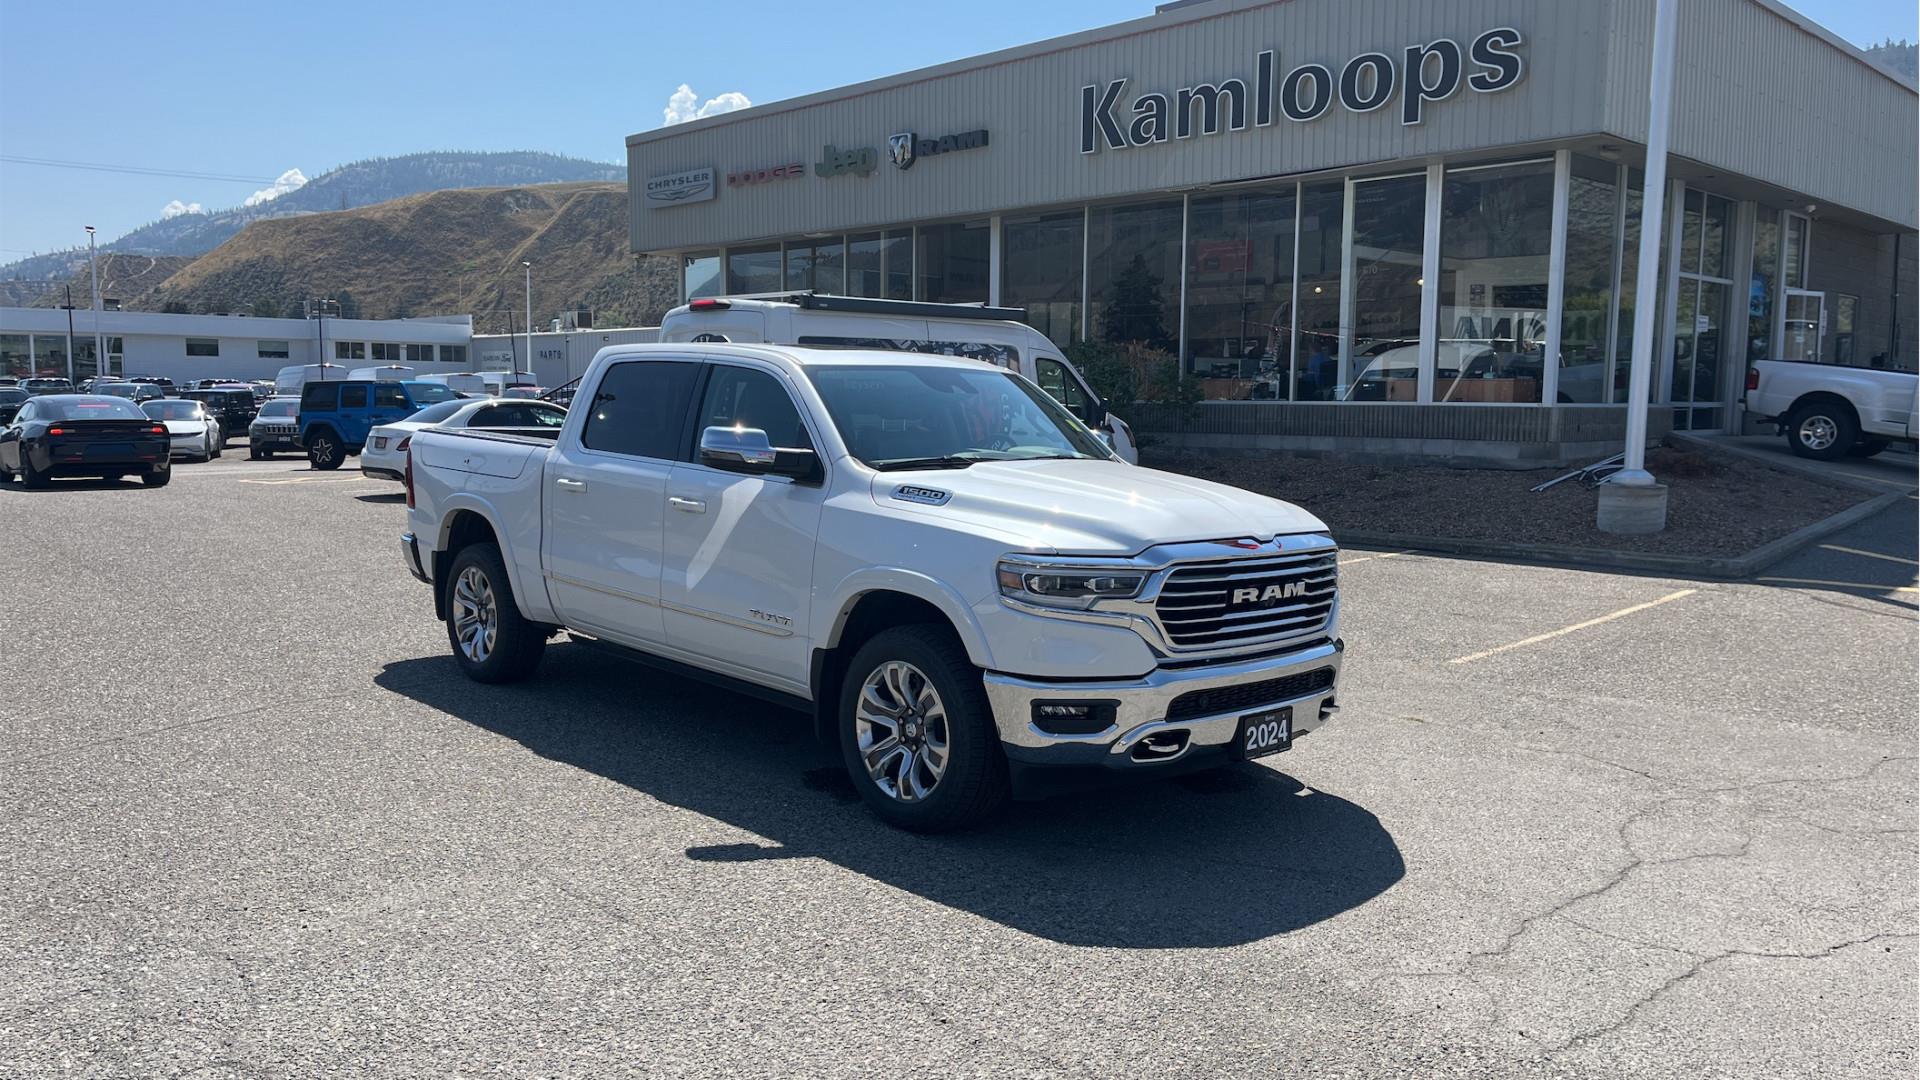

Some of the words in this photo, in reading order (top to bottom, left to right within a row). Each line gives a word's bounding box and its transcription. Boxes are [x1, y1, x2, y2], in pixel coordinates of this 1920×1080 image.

[1080, 27, 1524, 155] Kamloops
[916, 130, 989, 157] RAM
[815, 145, 878, 178] Jeep
[647, 172, 709, 190] CHRYSLER
[727, 162, 805, 188] DODGE
[902, 487, 943, 499] 1500
[1232, 582, 1306, 604] RAM
[1246, 719, 1288, 750] 2024
